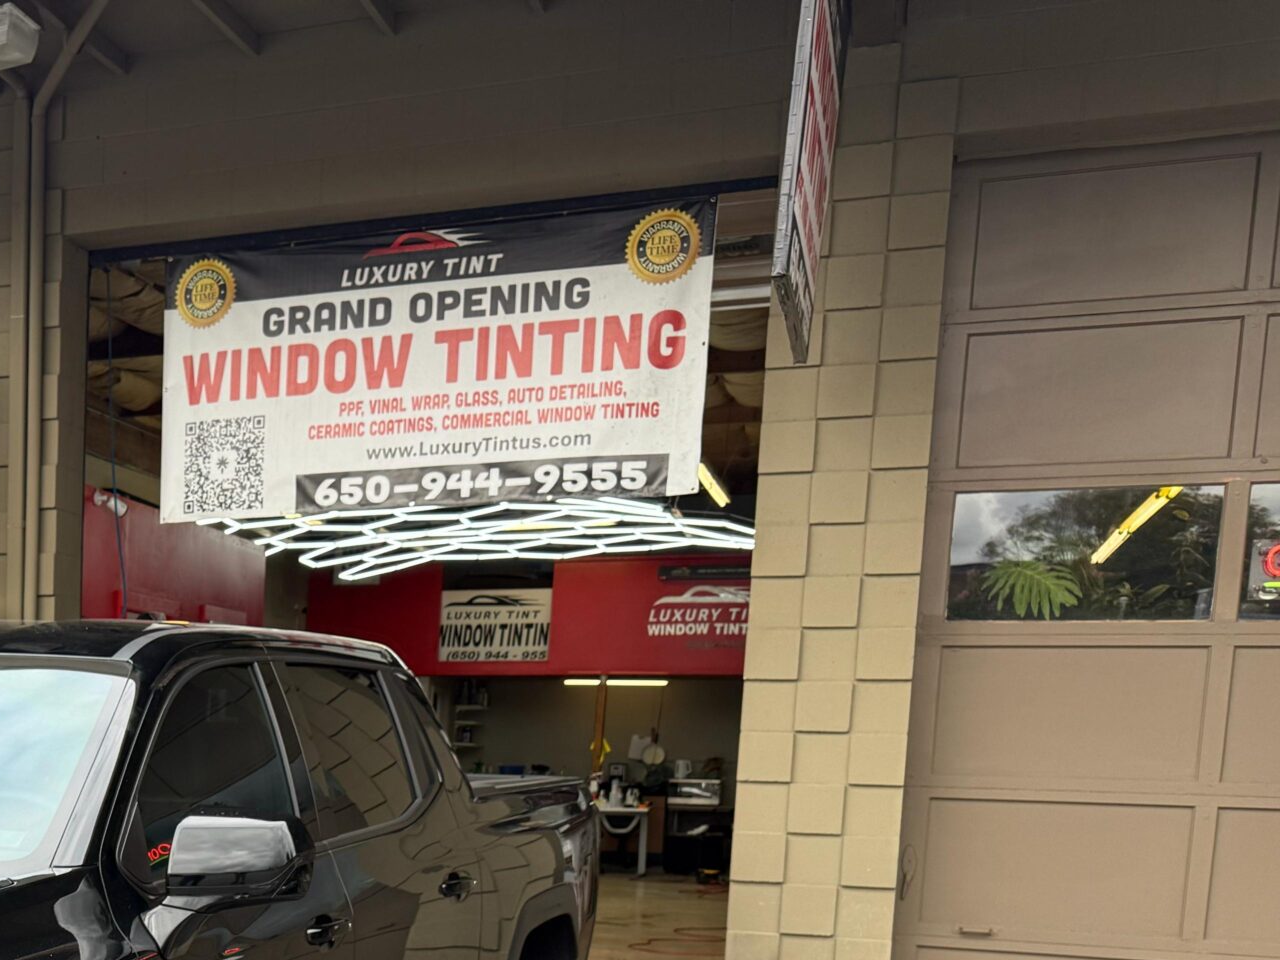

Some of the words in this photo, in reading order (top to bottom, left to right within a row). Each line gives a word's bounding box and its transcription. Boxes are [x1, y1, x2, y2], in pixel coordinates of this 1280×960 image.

[640, 220, 689, 242] WARRANTY
[650, 234, 678, 246] LIFE
[648, 244, 679, 256] TIME
[340, 260, 436, 289] LUXURY
[442, 253, 504, 278] TINT
[640, 252, 687, 274] WARRANTY
[187, 269, 225, 290] WARRANTY
[195, 282, 216, 293] LIFE
[193, 292, 218, 302] TIME
[262, 296, 393, 338] GRAND
[408, 277, 591, 324] OPENING
[182, 332, 414, 406] WINDOW
[433, 309, 687, 384] TINTING
[338, 401, 365, 417] PPF,
[369, 397, 407, 415] VINAL
[411, 393, 451, 411] WRAP,
[455, 389, 503, 408] GLASS,
[507, 386, 545, 405] AUTO
[548, 380, 628, 402] DETAILING,
[307, 421, 366, 441] CERAMIC
[369, 416, 438, 437] COATINGS,
[441, 410, 532, 431] COMMERCIAL
[537, 404, 597, 425] WINDOW
[601, 401, 661, 421] TINTING
[366, 432, 593, 461] www.LuxuryTintus.com
[313, 460, 649, 508] 650-944-9555
[446, 610, 501, 621] LUXURY
[506, 610, 541, 620] TINT
[647, 607, 723, 623] LUXURY
[728, 607, 749, 621] TI
[499, 622, 551, 647] TINTIN
[646, 622, 711, 637] WINDOW
[713, 622, 749, 636] TINT
[446, 650, 481, 662] (650)
[484, 650, 510, 660] 944
[521, 650, 547, 660] 955
